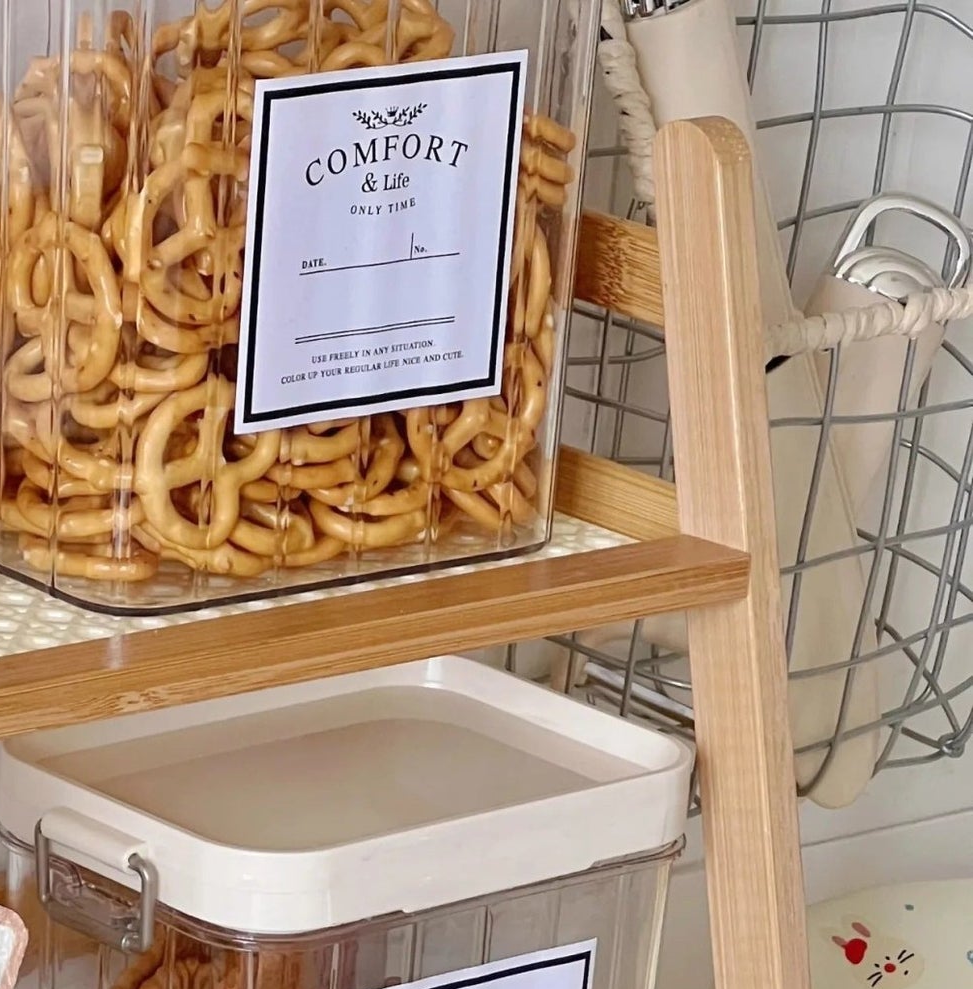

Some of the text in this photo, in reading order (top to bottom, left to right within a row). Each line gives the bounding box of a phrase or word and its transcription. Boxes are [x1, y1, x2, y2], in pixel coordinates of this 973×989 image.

[305, 133, 469, 186] COMFORT
[361, 172, 410, 193] & Life
[350, 198, 416, 215] ONLY TIME
[311, 355, 327, 364] USE
[329, 350, 359, 362] FREELY
[362, 348, 371, 357] IN
[372, 345, 389, 356] ANY
[281, 373, 306, 385] COLOR
[308, 371, 318, 380] UP
[321, 367, 342, 378] YOUR
[344, 362, 381, 374] REGULAR
[383, 359, 400, 369] LIFE
[402, 356, 421, 365] NICE
[423, 353, 441, 363] AND
